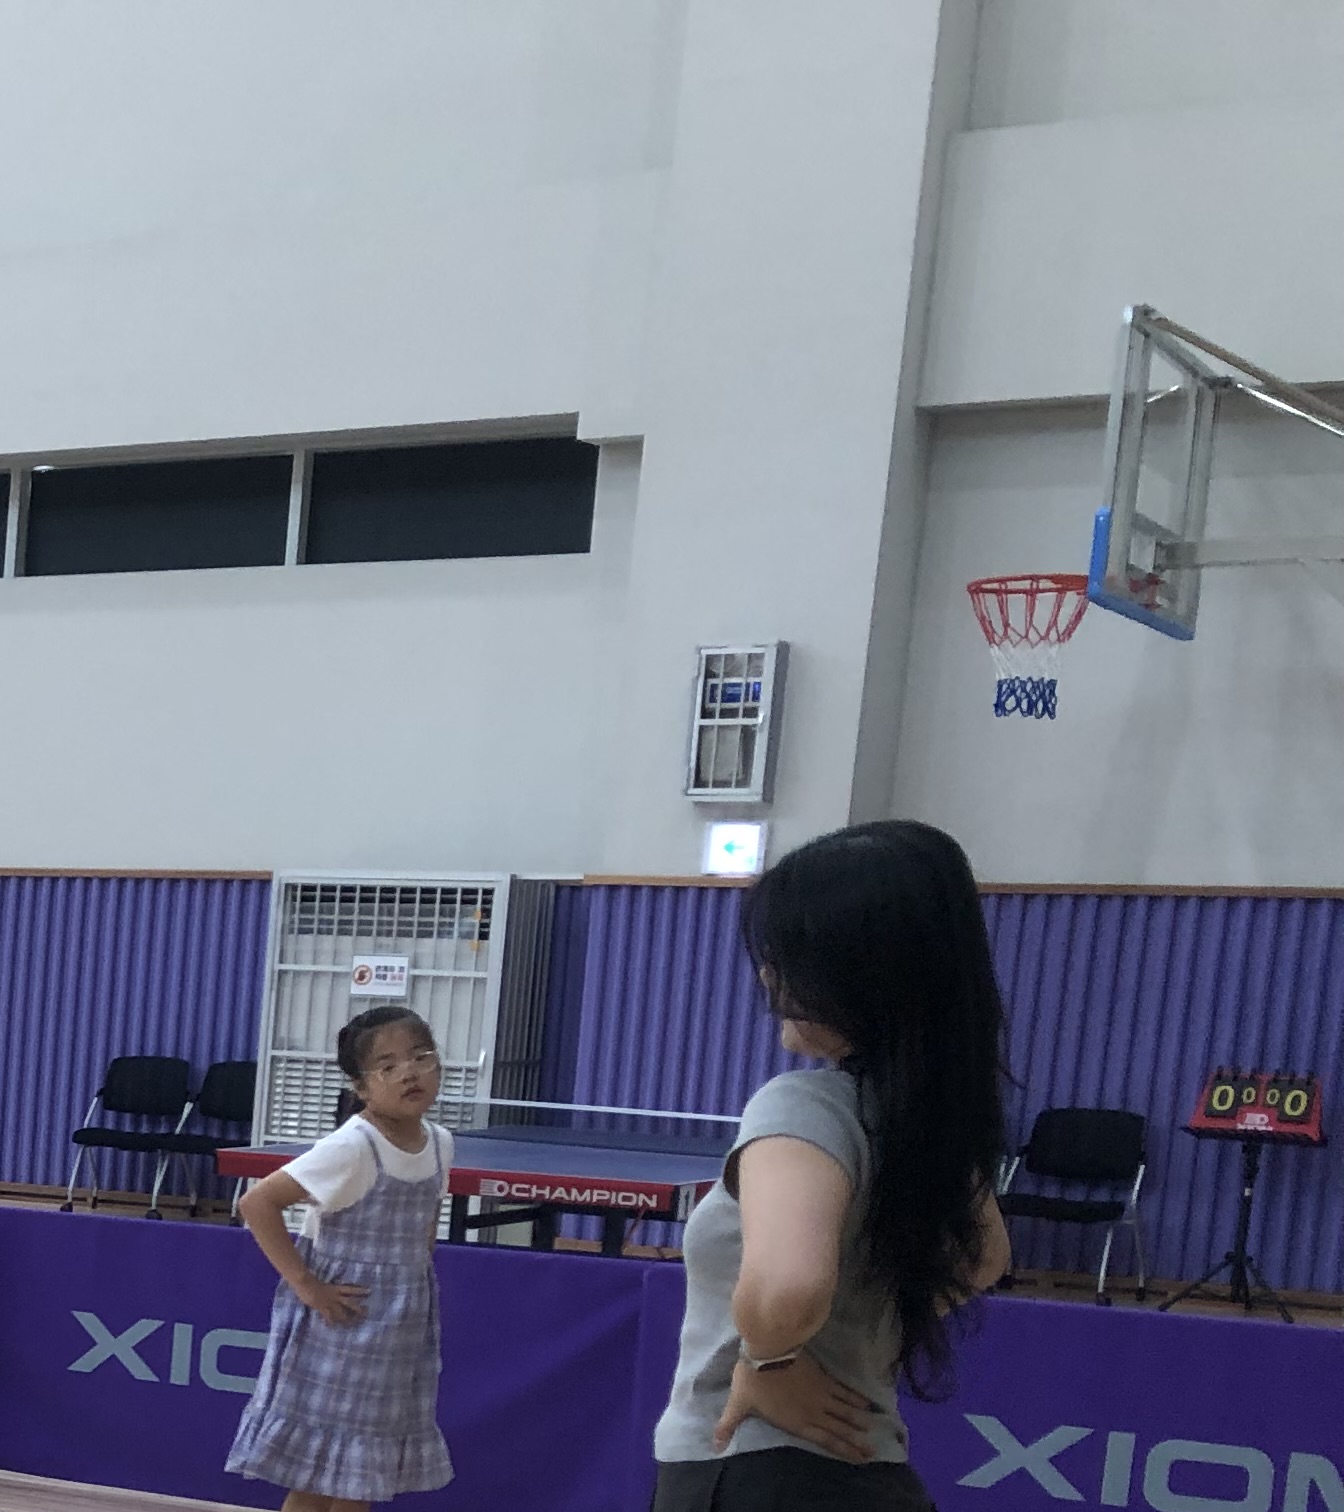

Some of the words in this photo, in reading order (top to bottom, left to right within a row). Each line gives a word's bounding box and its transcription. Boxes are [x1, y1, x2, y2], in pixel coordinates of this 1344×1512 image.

[1212, 1085, 1234, 1111] 0
[1243, 1086, 1256, 1104] 0
[1266, 1088, 1280, 1105] 0
[1284, 1090, 1308, 1116] 0
[511, 1184, 657, 1208] CHAMPION
[67, 1310, 277, 1395] XIO
